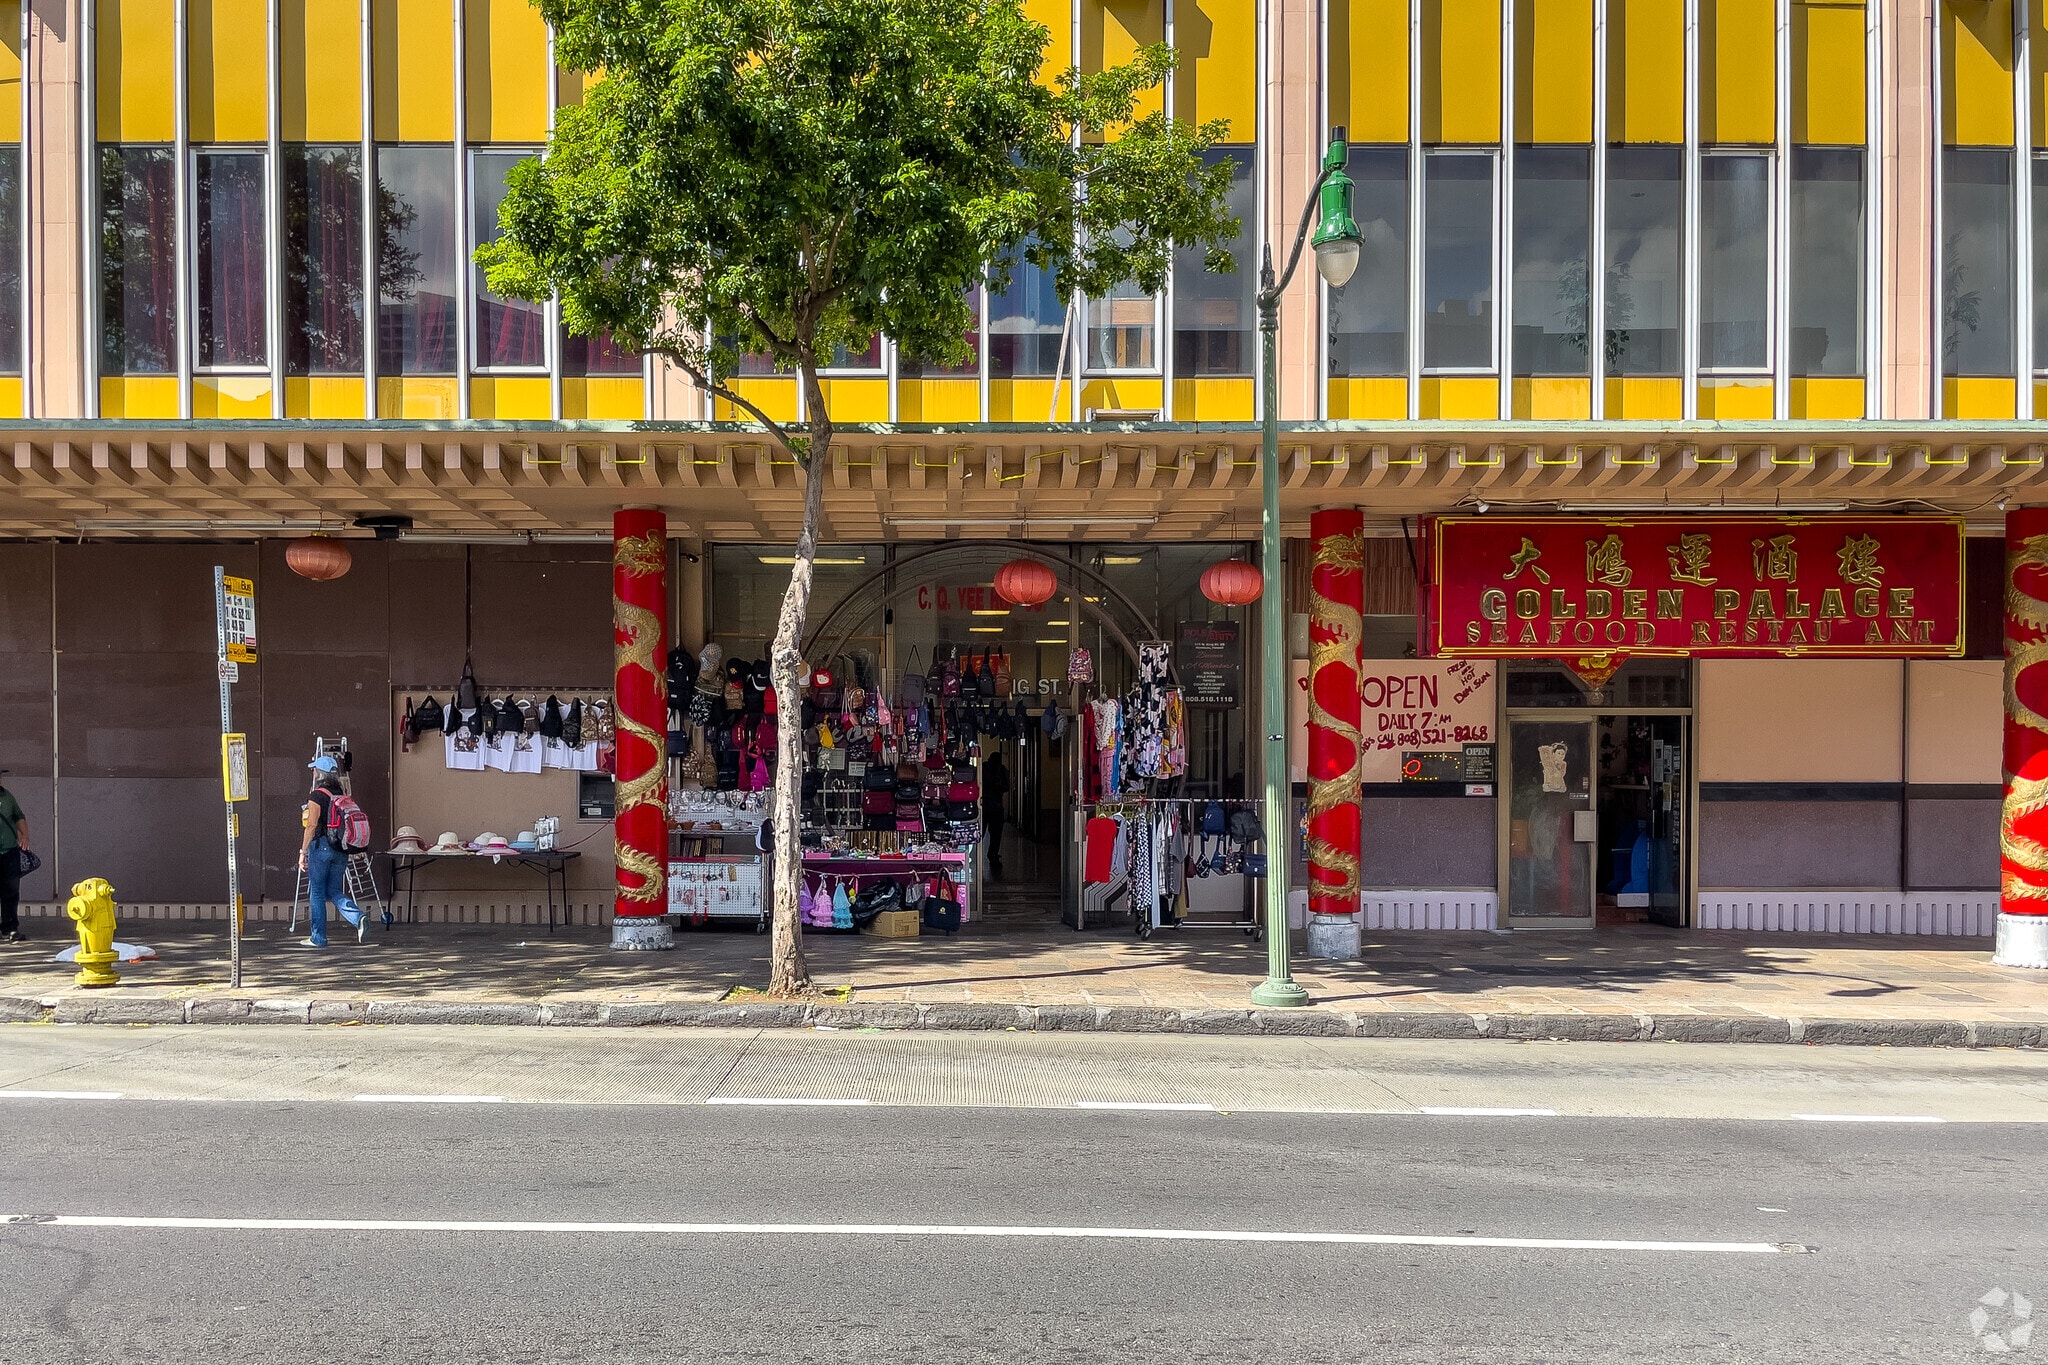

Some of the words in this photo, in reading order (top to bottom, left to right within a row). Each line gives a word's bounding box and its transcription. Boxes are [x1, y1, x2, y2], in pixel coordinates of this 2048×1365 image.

[1502, 532, 1886, 588] 大鴻運酒樓
[917, 585, 932, 610] C.
[956, 586, 985, 611] YEE
[1481, 587, 1685, 621] GOLDEN
[1713, 587, 1915, 620] PALACE
[1466, 620, 1656, 644] SEAFOOD
[1037, 678, 1063, 695] ST.
[1460, 667, 1476, 686] HOT
[1361, 674, 1439, 709] OPEN
[1378, 712, 1417, 732] DAILY
[1377, 732, 1396, 744] CALL
[1465, 747, 1491, 756] OPEN
